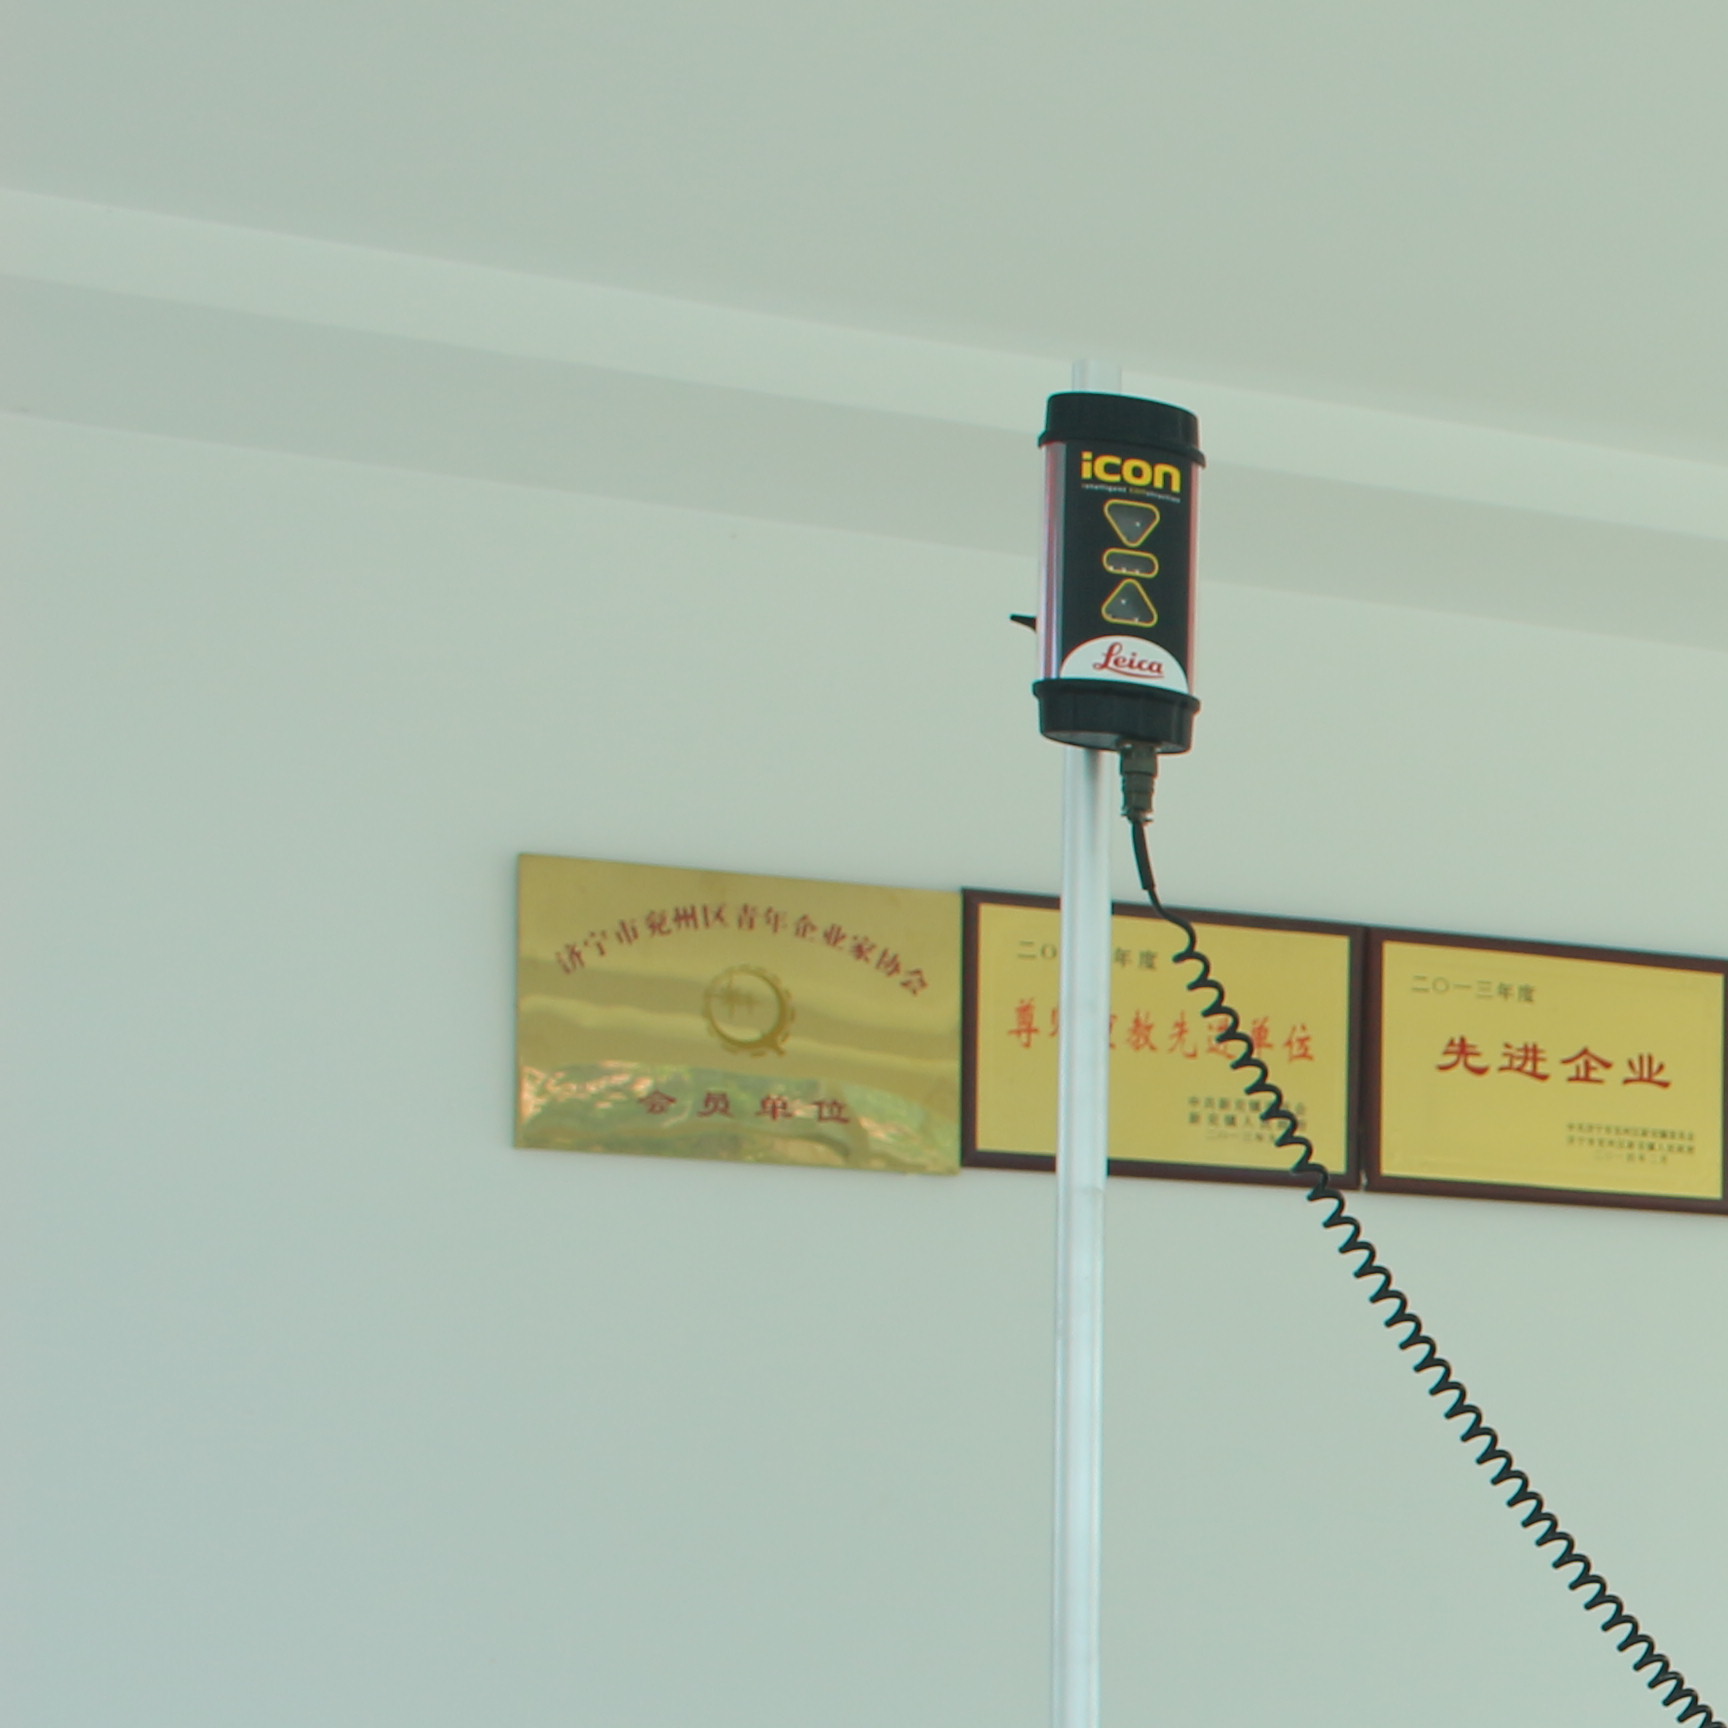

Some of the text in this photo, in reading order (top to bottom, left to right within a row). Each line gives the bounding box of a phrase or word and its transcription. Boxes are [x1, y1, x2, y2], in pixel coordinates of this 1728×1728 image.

[1093, 642, 1164, 678] Leica
[1436, 1035, 1672, 1089] 先进企业
[638, 1089, 852, 1125] 会员单位
